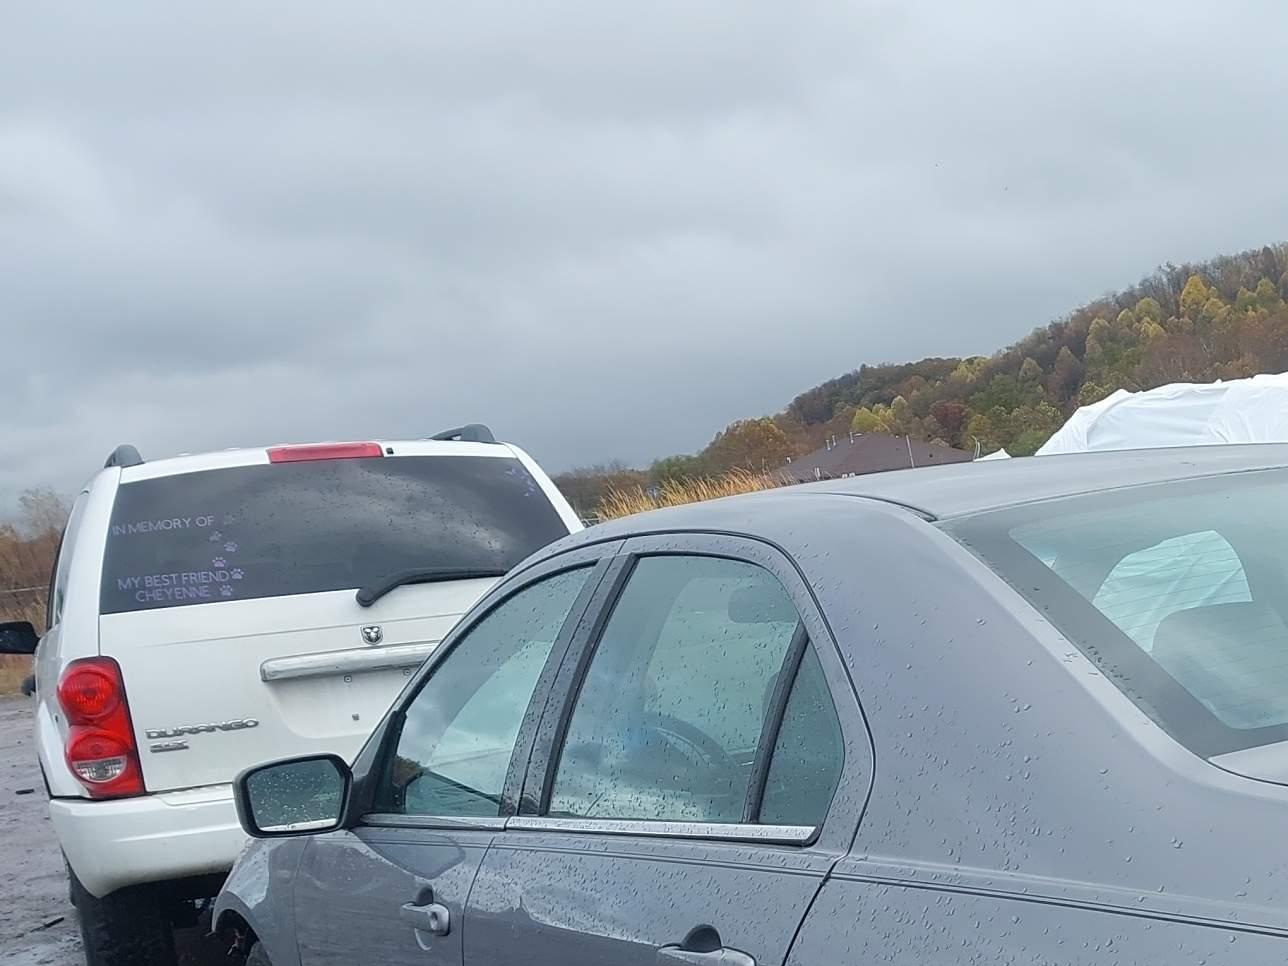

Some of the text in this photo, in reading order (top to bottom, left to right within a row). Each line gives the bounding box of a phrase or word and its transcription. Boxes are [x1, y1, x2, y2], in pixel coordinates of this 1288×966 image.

[112, 515, 215, 535] IN MEMORY OF
[118, 569, 230, 590] MY BEST FRIEND
[135, 585, 211, 602] CHEYENNE
[145, 718, 259, 739] DURANGO
